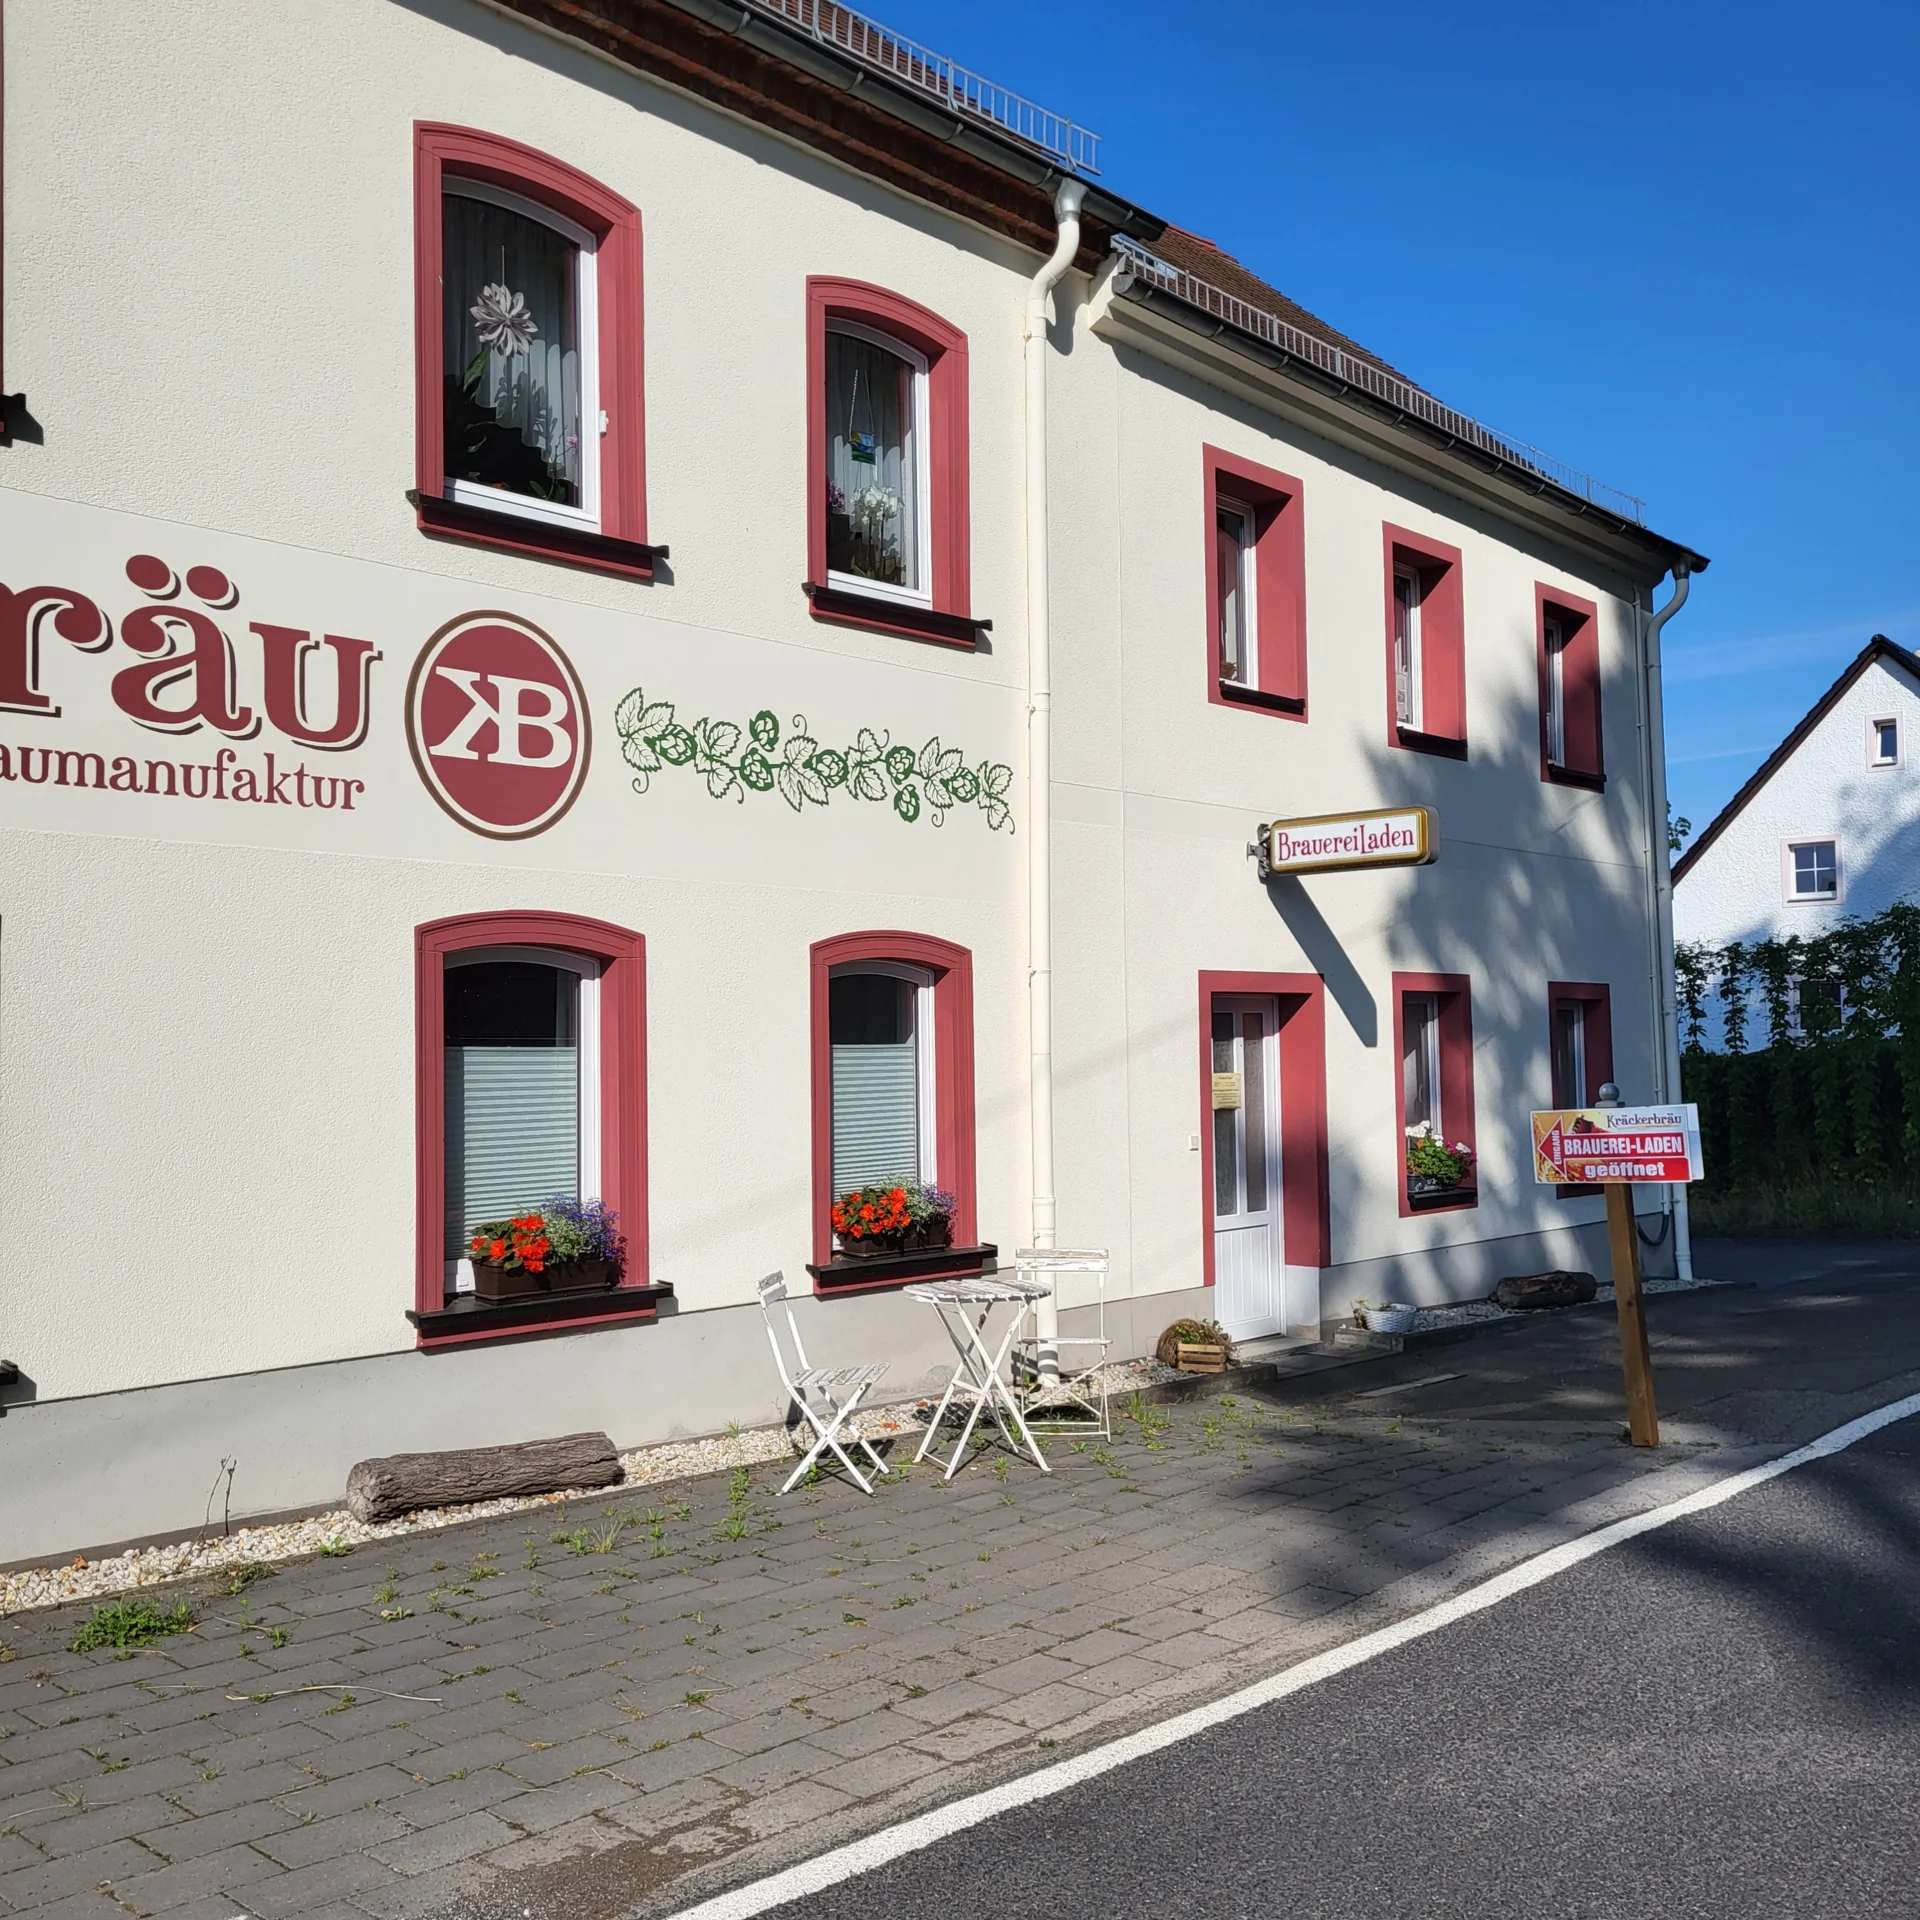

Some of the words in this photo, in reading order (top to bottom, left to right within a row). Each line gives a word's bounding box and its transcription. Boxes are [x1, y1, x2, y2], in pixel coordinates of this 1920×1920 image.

[1606, 1112, 1682, 1128] Kräckerbräu
[1552, 1130, 1562, 1165] EINGANG
[1564, 1136, 1682, 1154] BRAUEREI-LADEN
[1585, 1162, 1665, 1178] geöffnet
